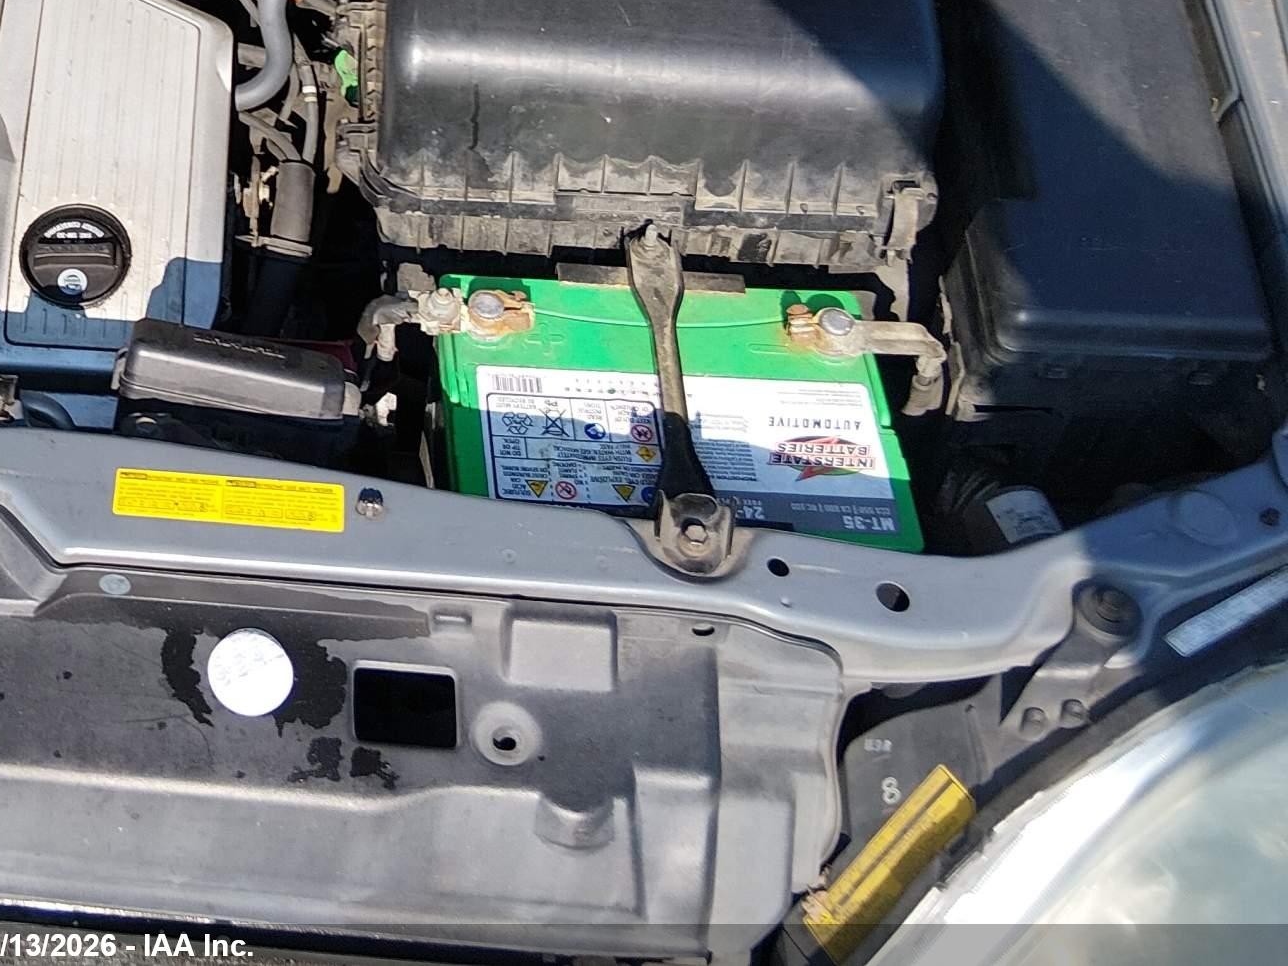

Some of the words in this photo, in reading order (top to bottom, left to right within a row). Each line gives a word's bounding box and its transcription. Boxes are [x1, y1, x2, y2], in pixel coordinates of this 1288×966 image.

[768, 416, 861, 430] AUTOMOTIVE
[777, 443, 868, 456] BATTERIES
[767, 452, 874, 468] INTERSTATE
[842, 515, 895, 531] MT-35
[881, 776, 902, 805] 8
